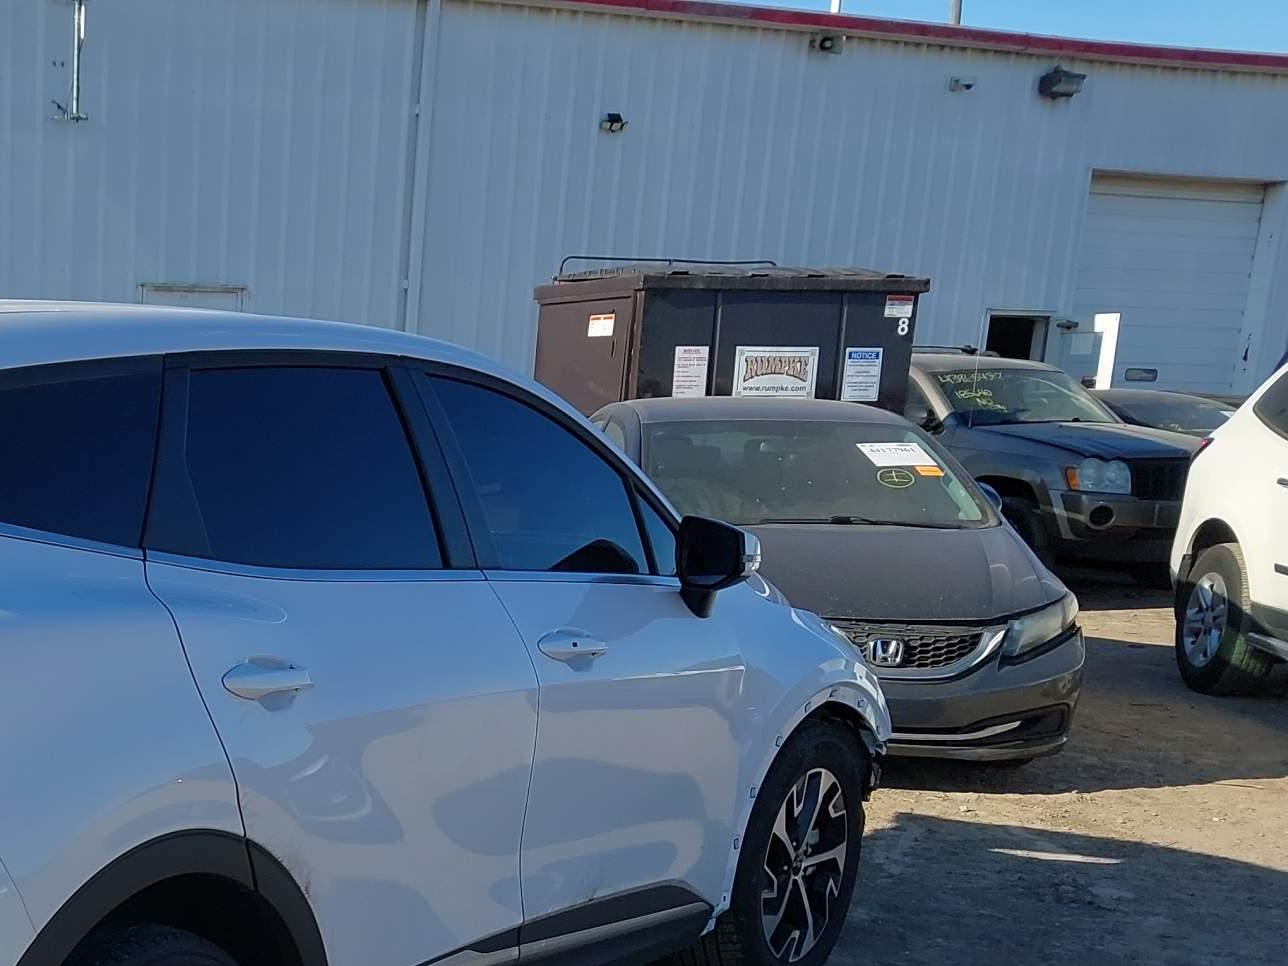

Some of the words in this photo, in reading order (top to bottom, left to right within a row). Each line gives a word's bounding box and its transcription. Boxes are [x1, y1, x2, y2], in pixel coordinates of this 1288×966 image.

[898, 318, 909, 335] 8
[743, 355, 809, 382] RUMPKE
[743, 384, 806, 393] www.rumpke.com
